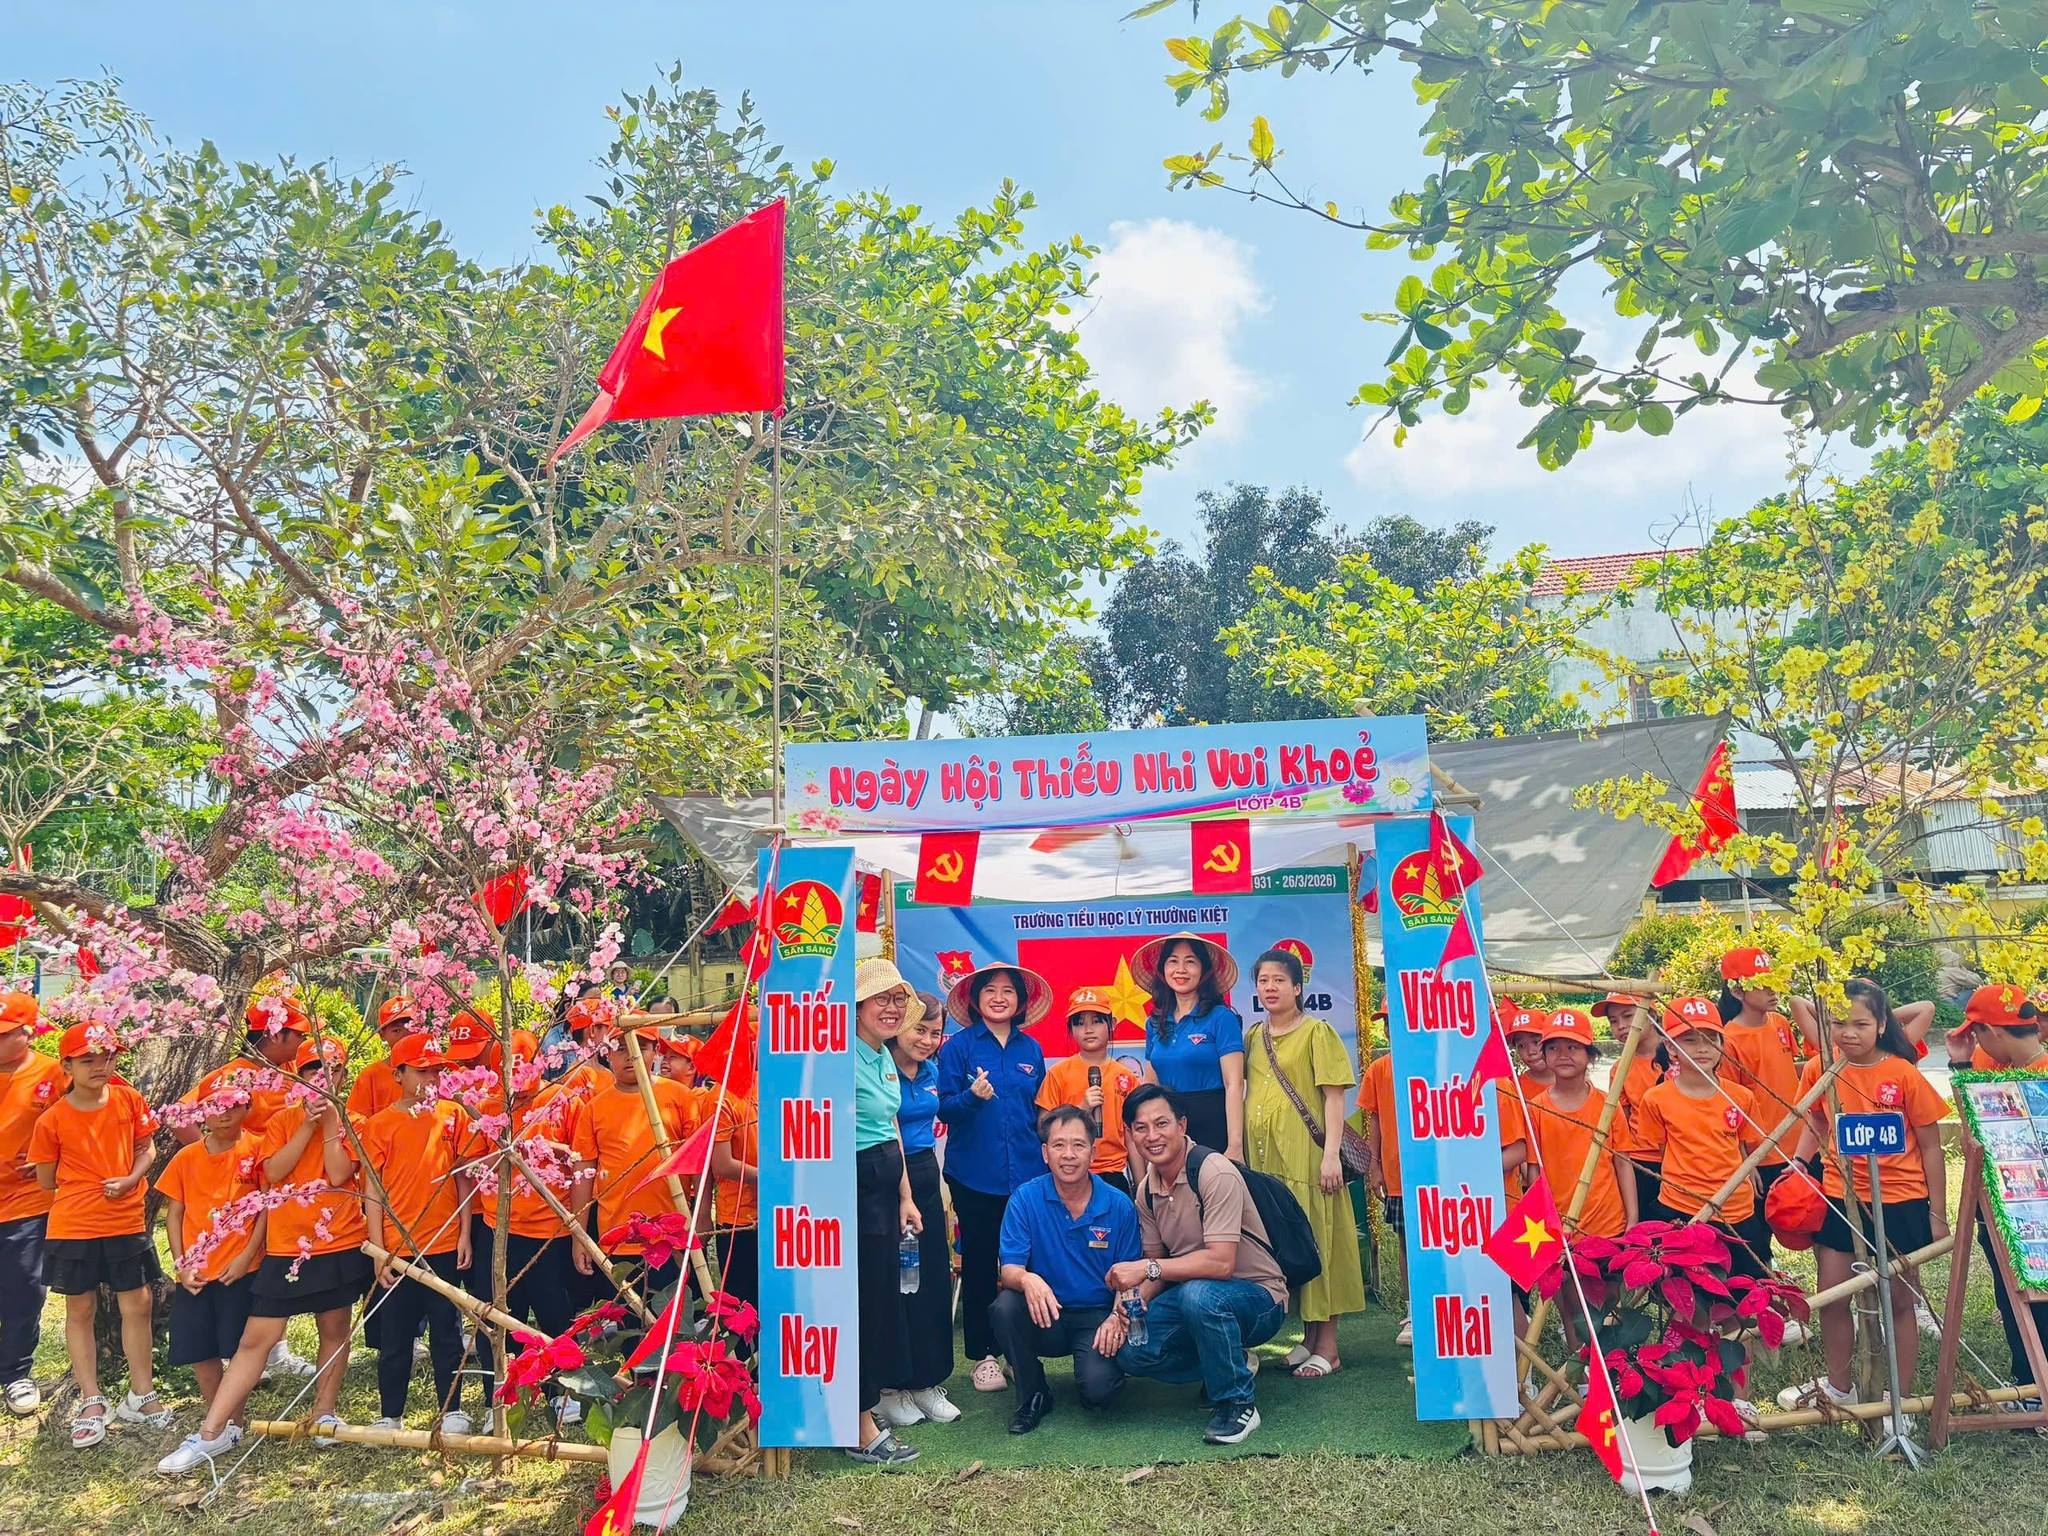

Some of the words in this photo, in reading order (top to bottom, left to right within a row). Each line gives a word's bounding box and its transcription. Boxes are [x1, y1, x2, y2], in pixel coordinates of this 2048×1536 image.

[829, 758, 928, 811] Ngày
[941, 754, 1001, 810] Hội
[1012, 741, 1121, 798] Thiếu
[1133, 750, 1196, 793] Nhi
[1206, 746, 1268, 789] Vui
[1279, 730, 1380, 785] Khoẻ
[1236, 795, 1273, 811] LỚP
[1279, 796, 1302, 810] 4B
[1254, 876, 1272, 889] 931
[1282, 873, 1336, 888] 26/3/2026)
[1013, 911, 1064, 929] TRƯỜNG
[1067, 907, 1095, 928] TIỂU
[1098, 911, 1124, 930] HỌC
[1128, 907, 1142, 925] LÝ
[1145, 906, 1197, 925] THƯỜNG
[1200, 905, 1229, 925] KIỆT
[766, 979, 848, 1054] Thiếu
[1303, 993, 1333, 1011] 4B
[1399, 968, 1477, 1037] Vững
[1513, 1013, 1530, 1027] 4B
[1553, 1013, 1575, 1027] 4B
[1683, 1001, 1708, 1015] 4B
[781, 1098, 833, 1162] Nhi
[1408, 1074, 1486, 1141] Bước
[1845, 1122, 1875, 1146] LỚP
[1880, 1125, 1898, 1145] 4B
[773, 1204, 842, 1269] Hôm
[1416, 1183, 1494, 1257] Ngày
[780, 1313, 840, 1384] Nay
[1433, 1294, 1494, 1359] Mai
